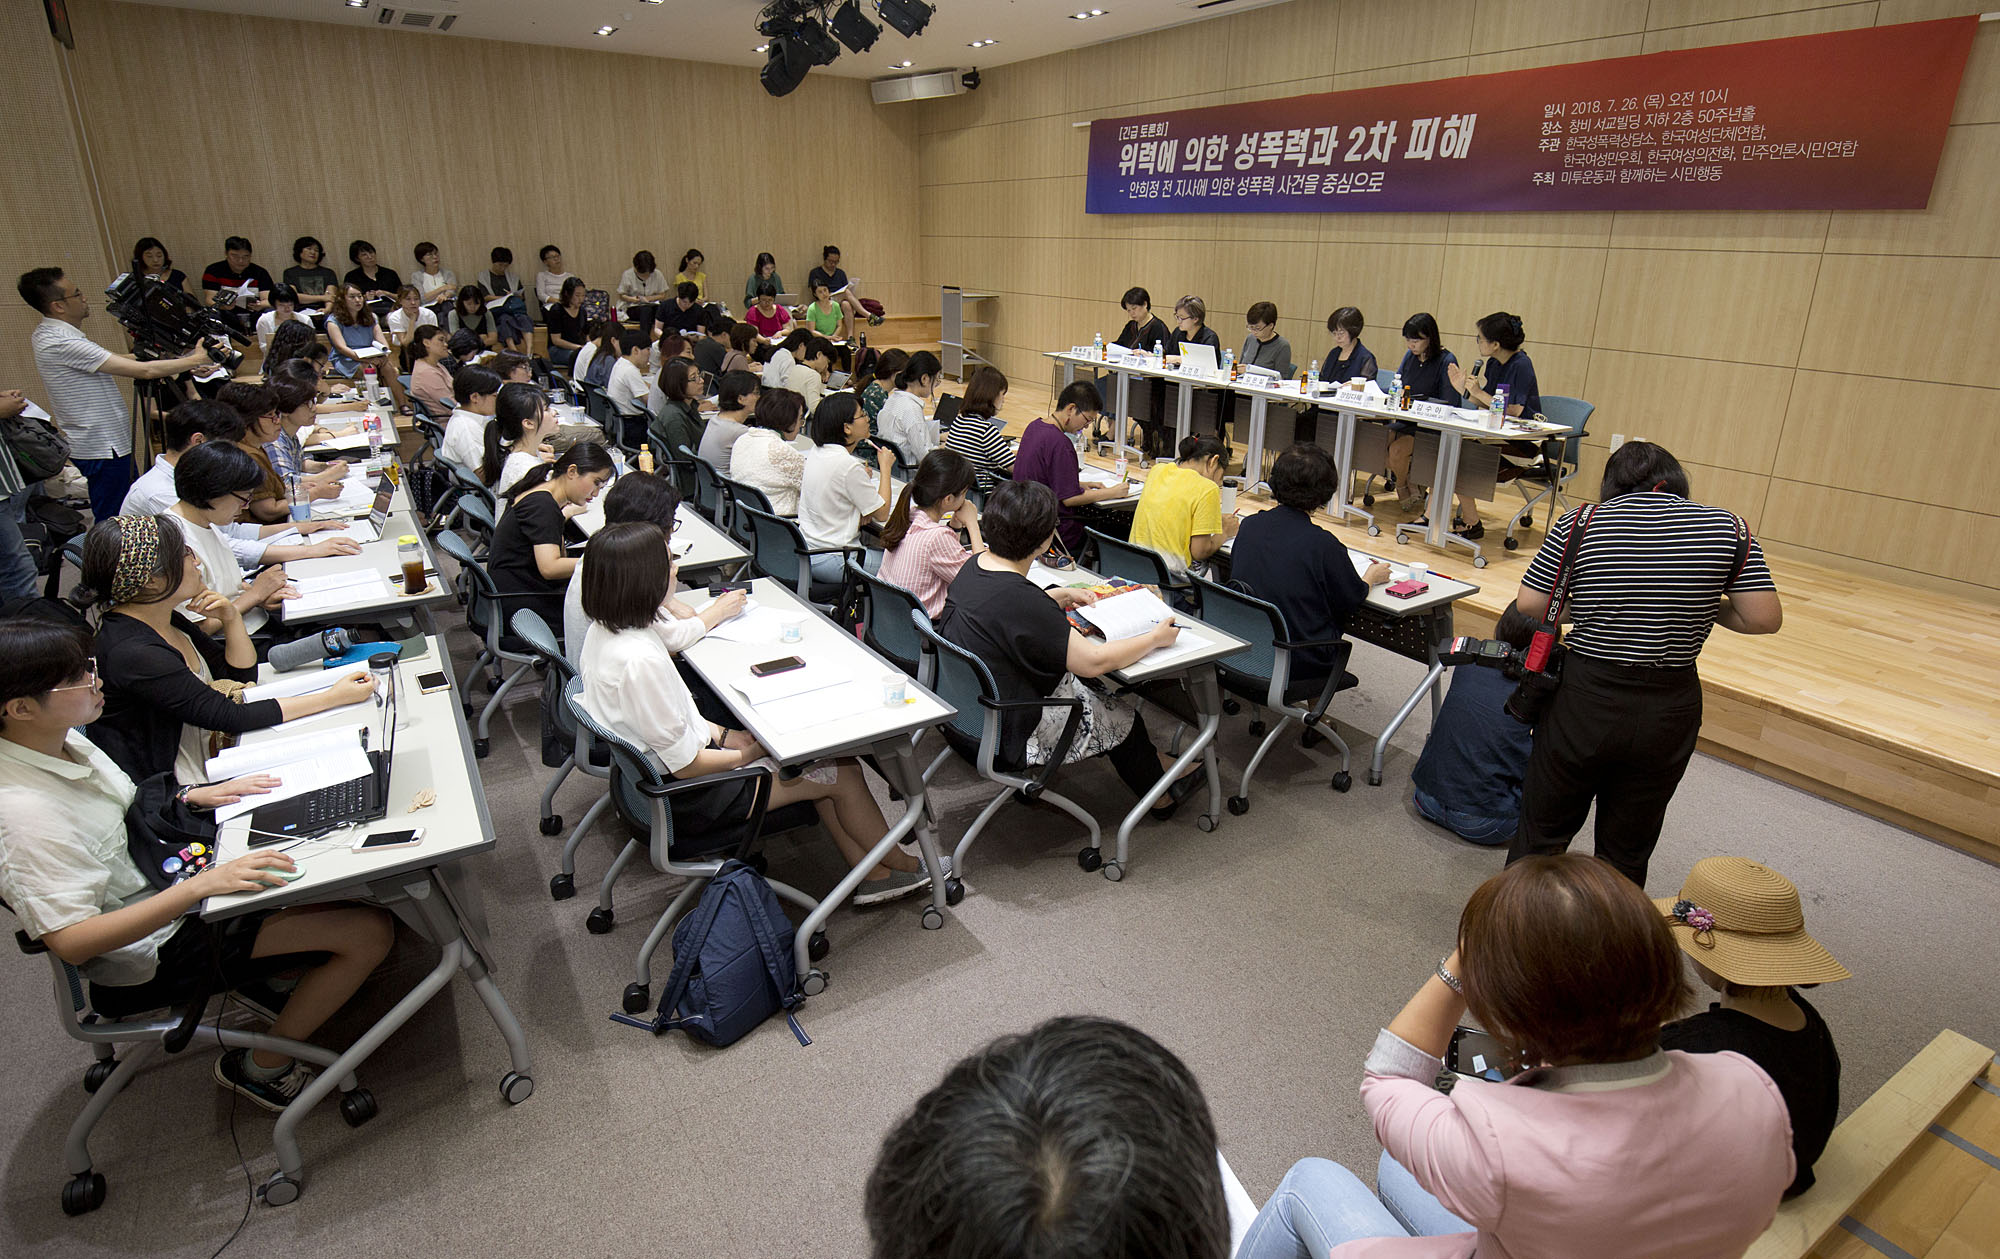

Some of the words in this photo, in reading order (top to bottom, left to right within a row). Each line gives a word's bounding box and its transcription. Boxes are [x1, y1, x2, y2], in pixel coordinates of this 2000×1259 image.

[1544, 103, 1566, 118] 일시
[1571, 100, 1602, 115] 2018.
[1607, 99, 1617, 112] 7.
[1621, 97, 1639, 111] 26.
[1644, 93, 1665, 110] (목)
[1667, 90, 1695, 107] 오전
[1699, 87, 1728, 104] 10시
[1118, 126, 1139, 141] [긴급
[1140, 121, 1169, 138] 토론회]
[1541, 120, 1562, 136] 장소
[1569, 118, 1592, 133] 창비
[1594, 114, 1641, 131] 서교빌딩
[1644, 111, 1670, 127] 지하
[1672, 109, 1694, 126] 2층
[1697, 105, 1756, 123] 50주년홀
[1118, 139, 1179, 176] 위력에
[1182, 134, 1229, 172] 의한
[1234, 126, 1339, 171] 성폭력과
[1343, 120, 1398, 163] 2차
[1403, 113, 1477, 161] 피해
[1538, 137, 1561, 152] 주관
[1742, 140, 1859, 160] 민주언론시민연합
[1129, 179, 1160, 199] 안희정
[1162, 180, 1173, 198] 전
[1174, 178, 1208, 197] 지사에
[1210, 176, 1235, 197] 의한
[1237, 175, 1275, 196] 성폭력
[1277, 173, 1320, 195] 사건을
[1321, 172, 1385, 194] 중심으로
[1532, 171, 1555, 186] 주최
[1561, 169, 1616, 185] 미투운동과
[1620, 167, 1667, 184] 함께하는
[1670, 165, 1723, 182] 시민행동
[1547, 600, 1560, 622] EOS
[1554, 587, 1563, 599] 5D
